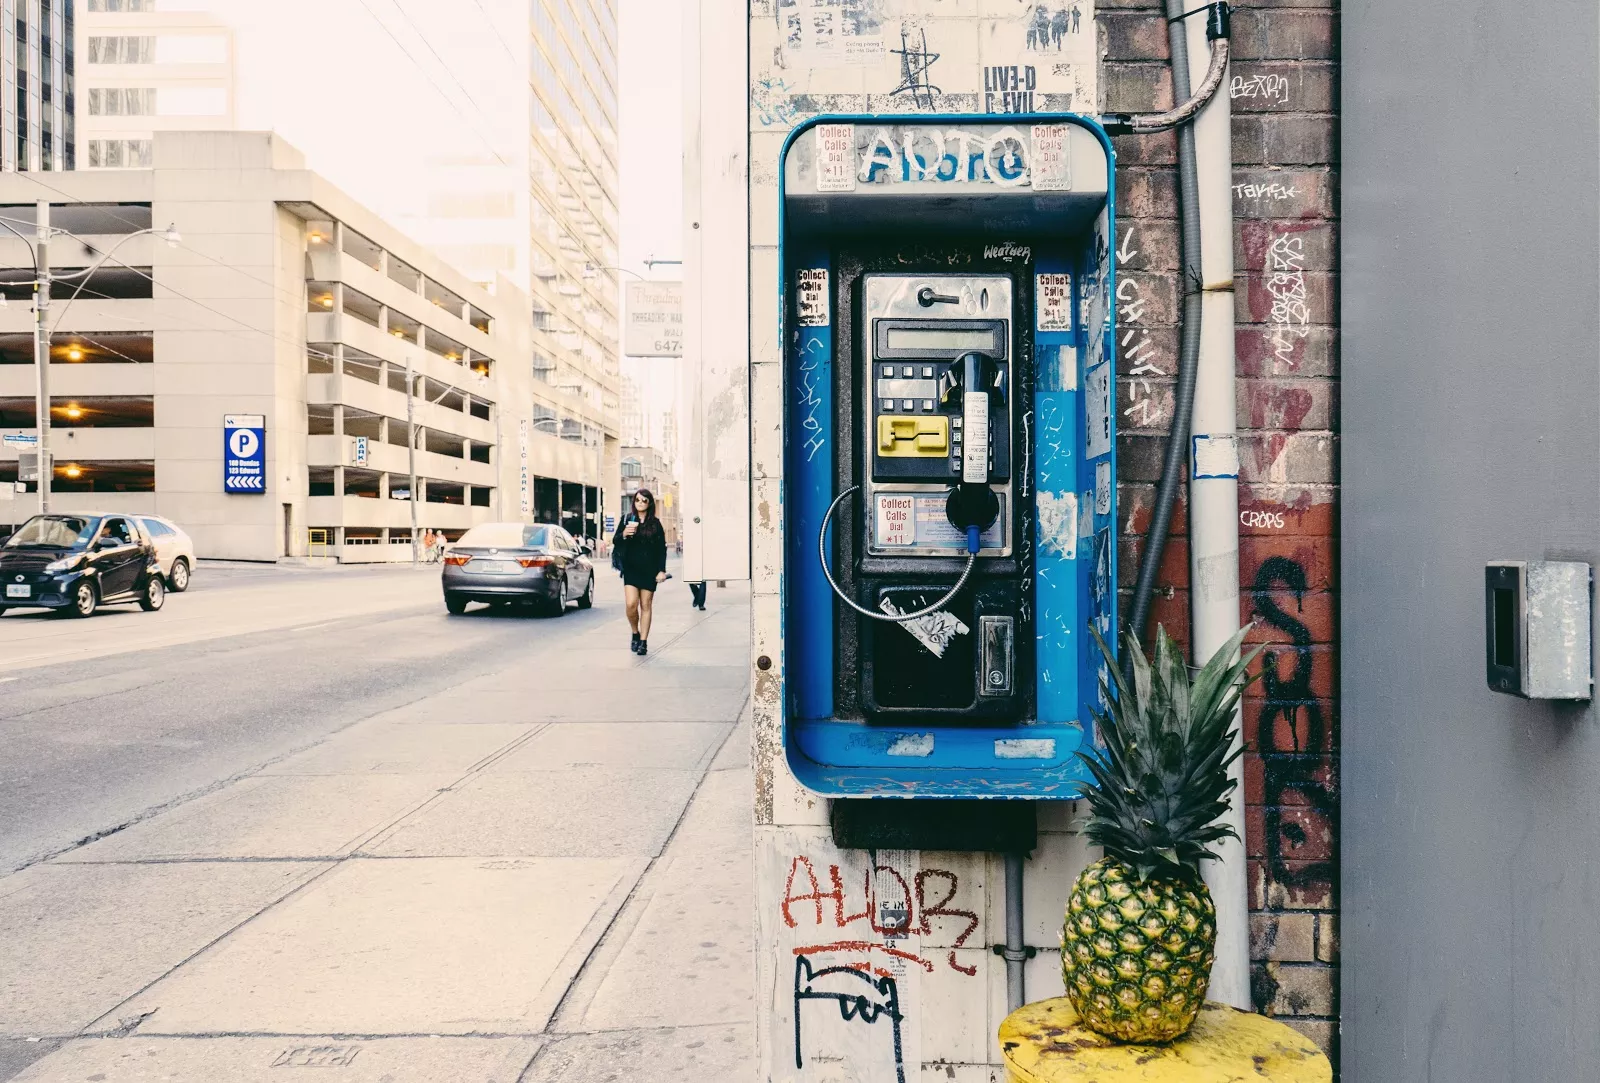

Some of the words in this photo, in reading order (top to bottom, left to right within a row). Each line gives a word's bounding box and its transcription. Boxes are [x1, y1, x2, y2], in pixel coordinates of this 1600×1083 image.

[820, 127, 851, 138] Collect
[1034, 127, 1066, 138] Collect
[824, 140, 847, 151] Calls
[1040, 140, 1062, 150] Calls
[828, 152, 843, 162] Dial
[1044, 152, 1058, 161] Dial
[798, 270, 826, 280] Collect
[1040, 275, 1069, 285] Collect
[239, 435, 249, 452] P
[881, 499, 911, 509] Collect
[885, 511, 907, 521] Calls
[889, 523, 903, 531] Dial
